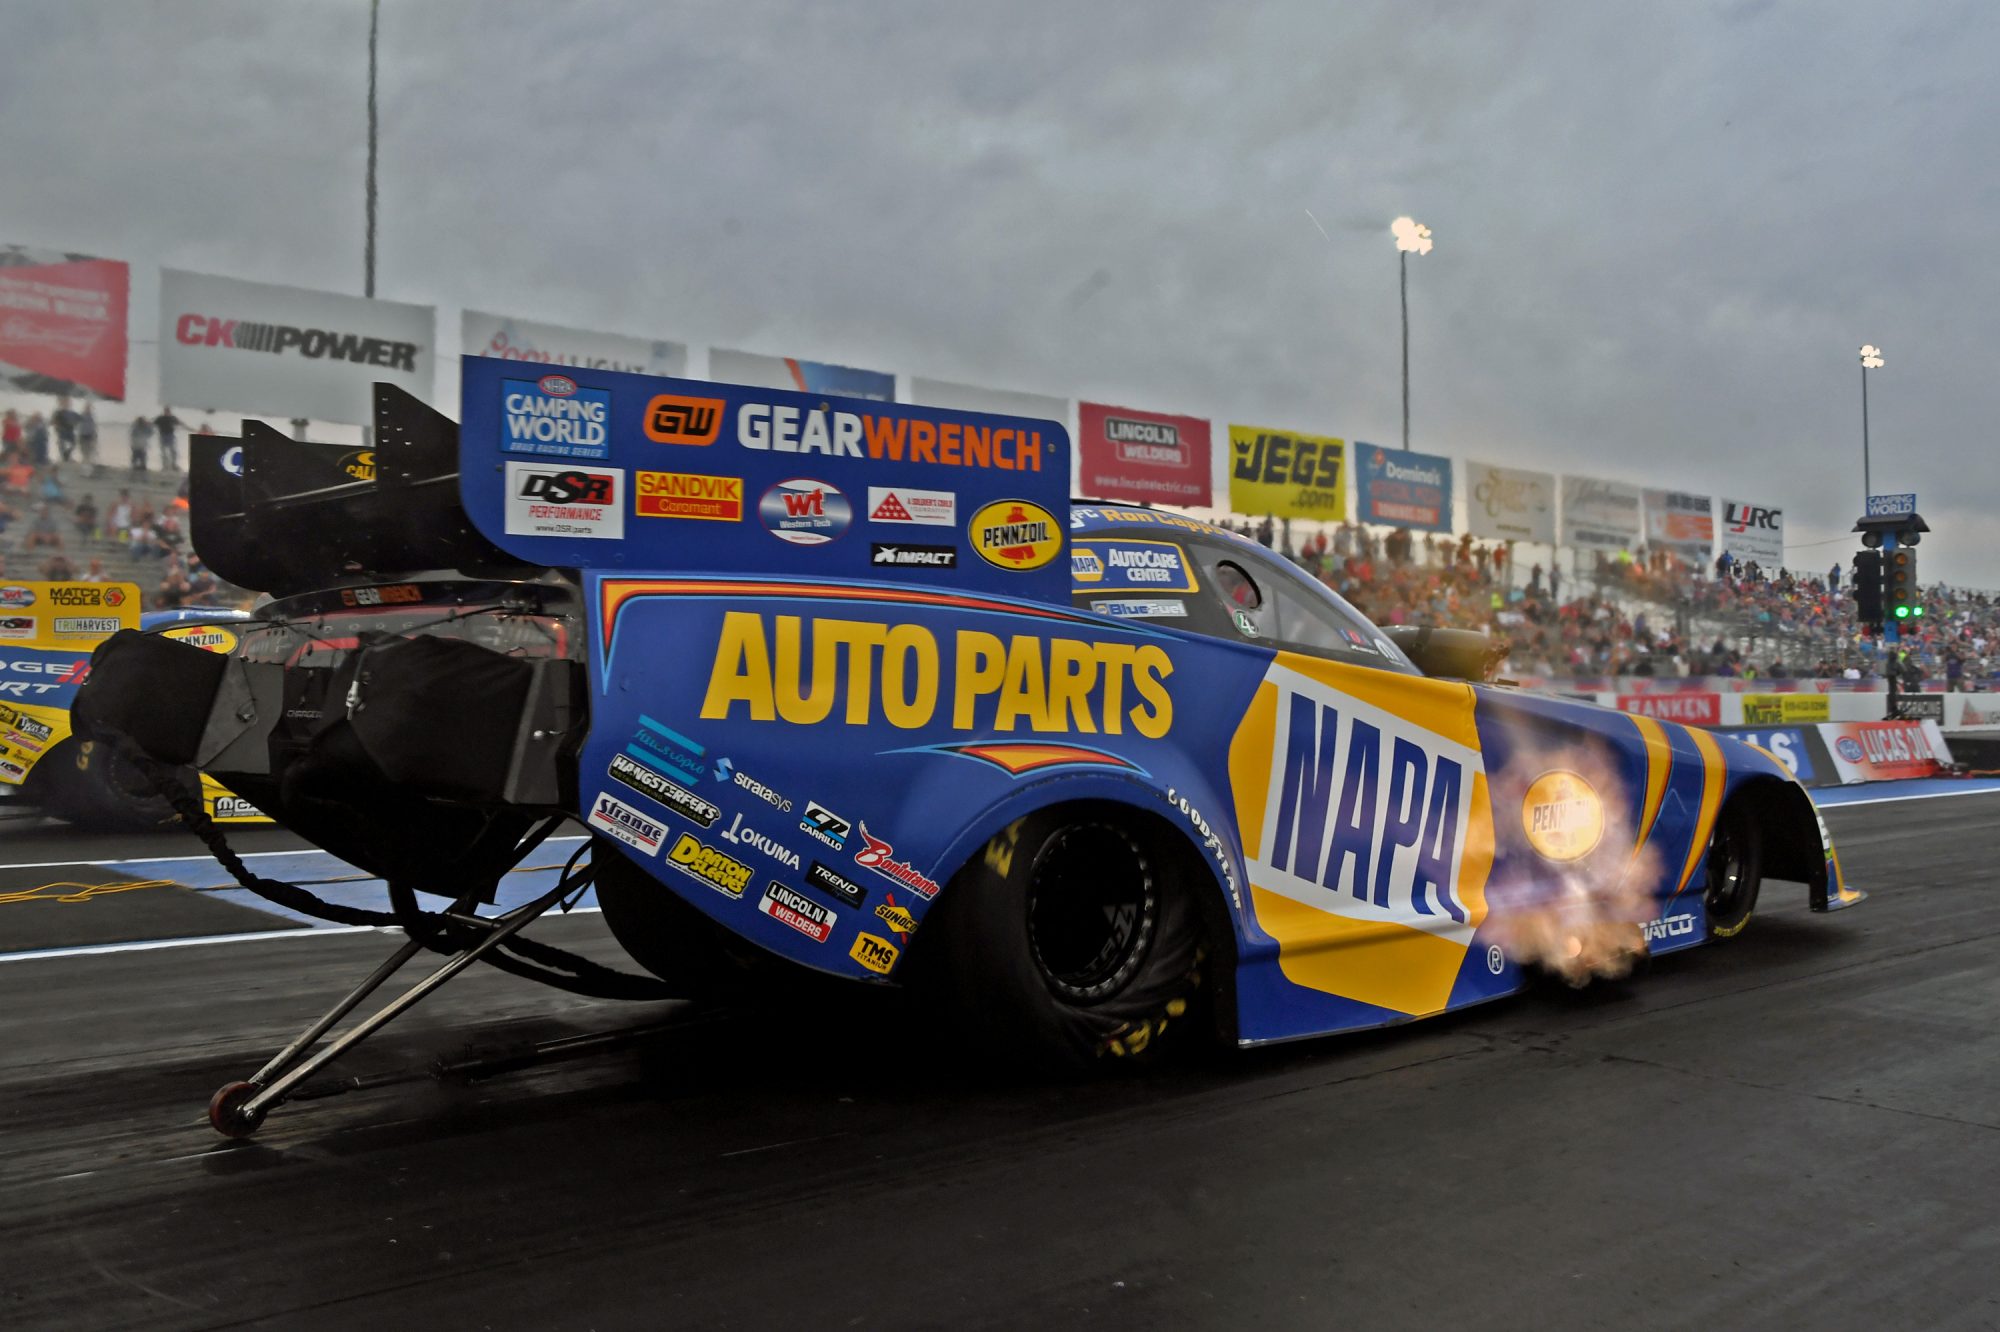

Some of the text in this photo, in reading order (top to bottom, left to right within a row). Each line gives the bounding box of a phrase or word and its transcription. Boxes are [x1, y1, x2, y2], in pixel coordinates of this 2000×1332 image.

[505, 393, 606, 423] CAMPING
[506, 414, 606, 446] WORLD
[1108, 421, 1178, 445] LINCOLN
[1123, 444, 1183, 463] WELDERS
[1234, 433, 1345, 489] JEGS
[520, 471, 610, 505] DSR
[639, 473, 739, 500] SANDVIK
[1867, 494, 1914, 506] CAMPING
[527, 505, 603, 521] PERFORMANCE
[658, 498, 722, 514] Coromant
[1099, 508, 1154, 522] Ron
[1867, 503, 1914, 516] WORLD
[780, 519, 833, 529] Western Tech
[983, 521, 1050, 549] PENNZOIL
[1126, 568, 1172, 582] CENTER
[49, 587, 101, 598] MATCO
[49, 597, 101, 606] TOOLS
[57, 619, 118, 631] TRUHARVEST
[699, 610, 1174, 740] AUTO PARTS
[1859, 728, 1910, 763] LUCAS
[612, 756, 717, 820] HANGSTERFER'S
[734, 771, 793, 813] stratasys
[596, 799, 662, 840] Strange
[1270, 691, 1466, 925] NAPA
[606, 827, 638, 846] AXLES
[741, 828, 800, 870] OKUMA
[799, 821, 843, 852] CARRILLO
[669, 835, 753, 883] DARTON
[689, 859, 746, 893] SLEEVES
[815, 865, 859, 894] TREND
[769, 884, 825, 923] LINCOLN
[775, 905, 823, 938] WELDERS
[876, 905, 918, 932] SUNOCO
[860, 937, 893, 965] TMS
